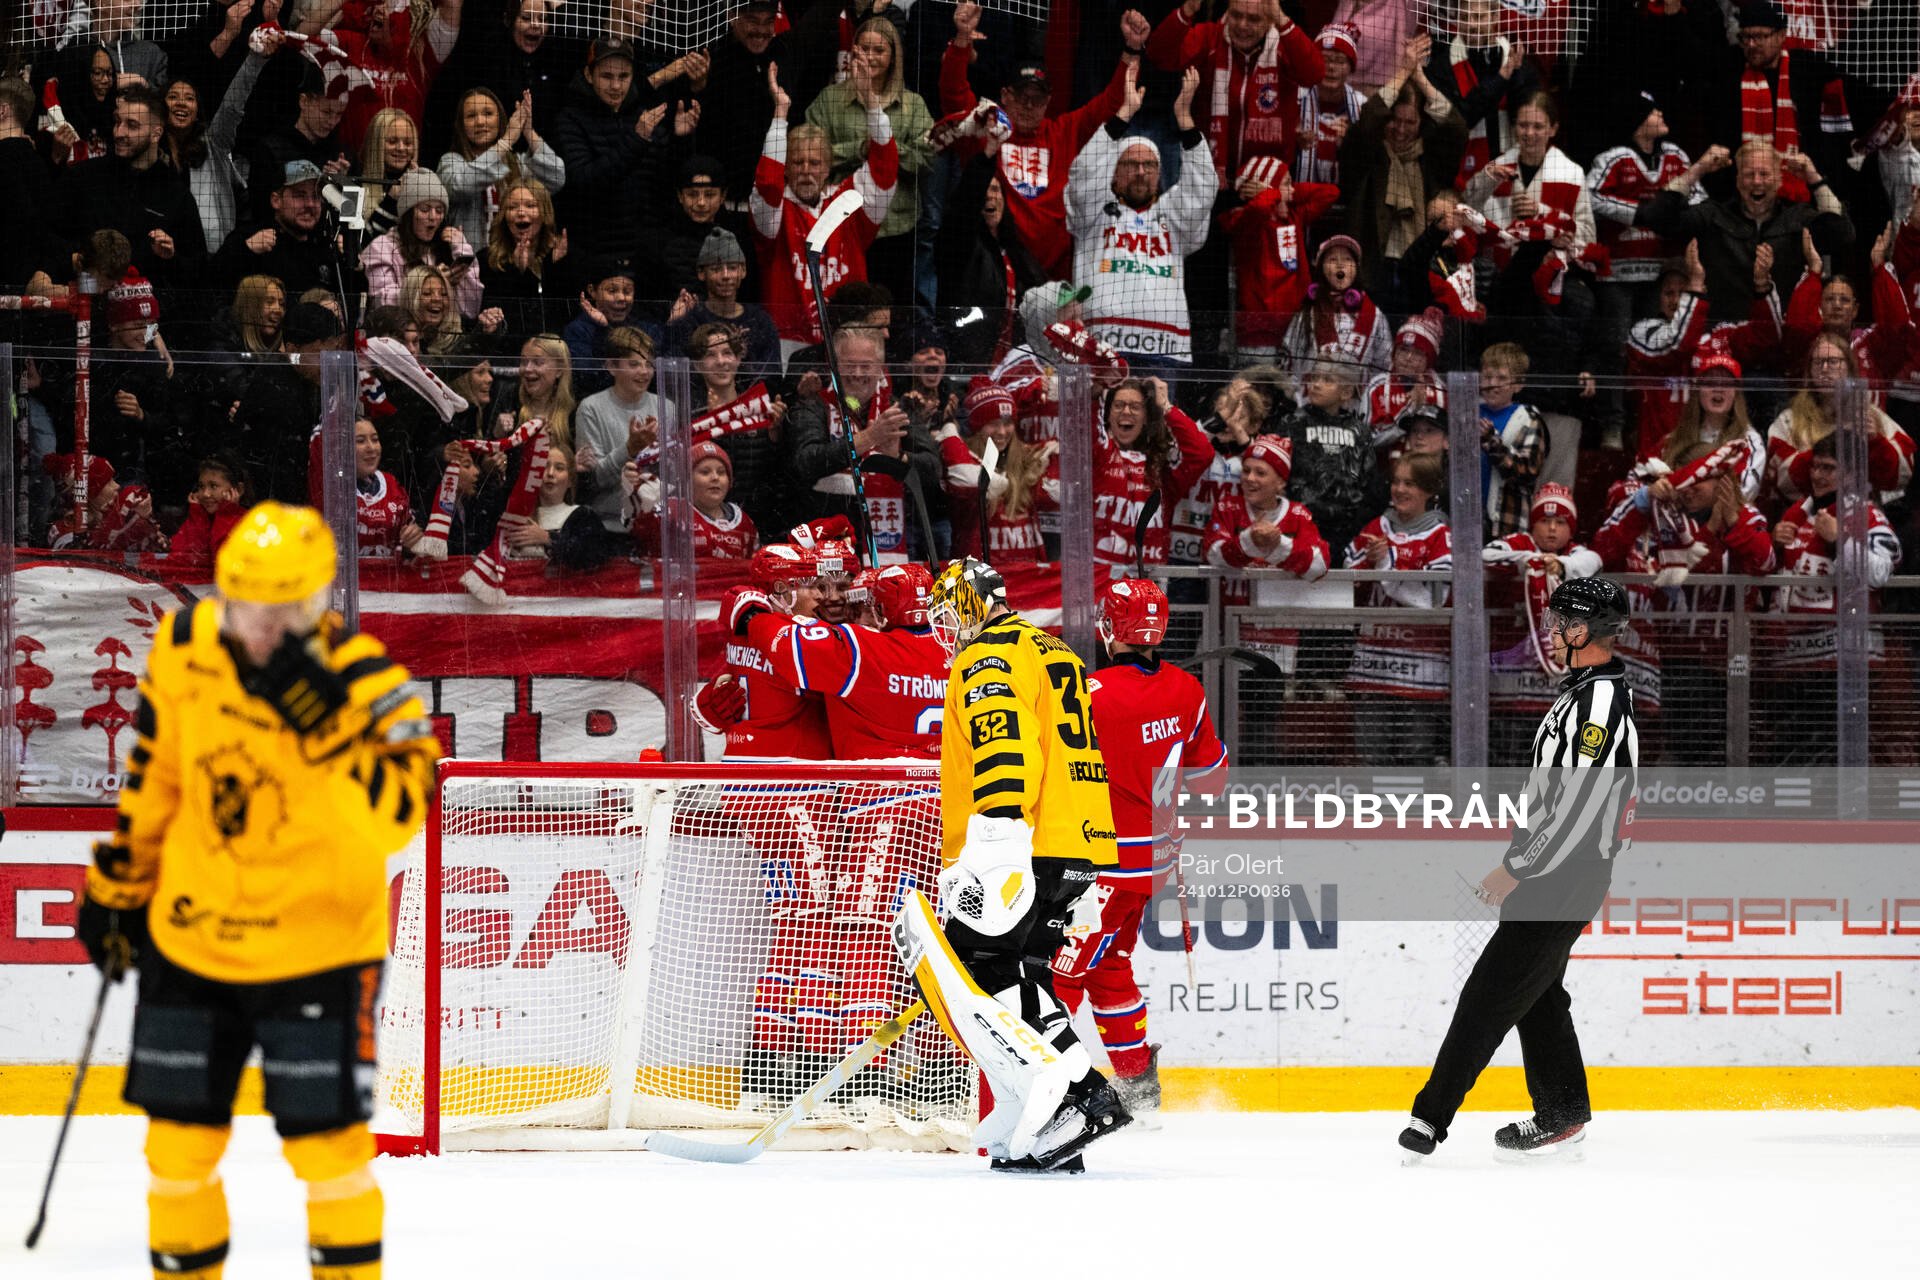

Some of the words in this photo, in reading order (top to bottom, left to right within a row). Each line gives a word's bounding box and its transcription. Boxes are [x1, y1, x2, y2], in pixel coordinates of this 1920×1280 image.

[968, 657, 1005, 677] HOLMEN
[974, 711, 1009, 743] 32
[906, 768, 935, 778] Nordic
[1524, 832, 1549, 864] CCM
[1169, 981, 1340, 1012] REJLERS
[1642, 971, 1842, 1015] steel
[973, 1012, 1030, 1066] CCM
[998, 1011, 1057, 1064] CCM
